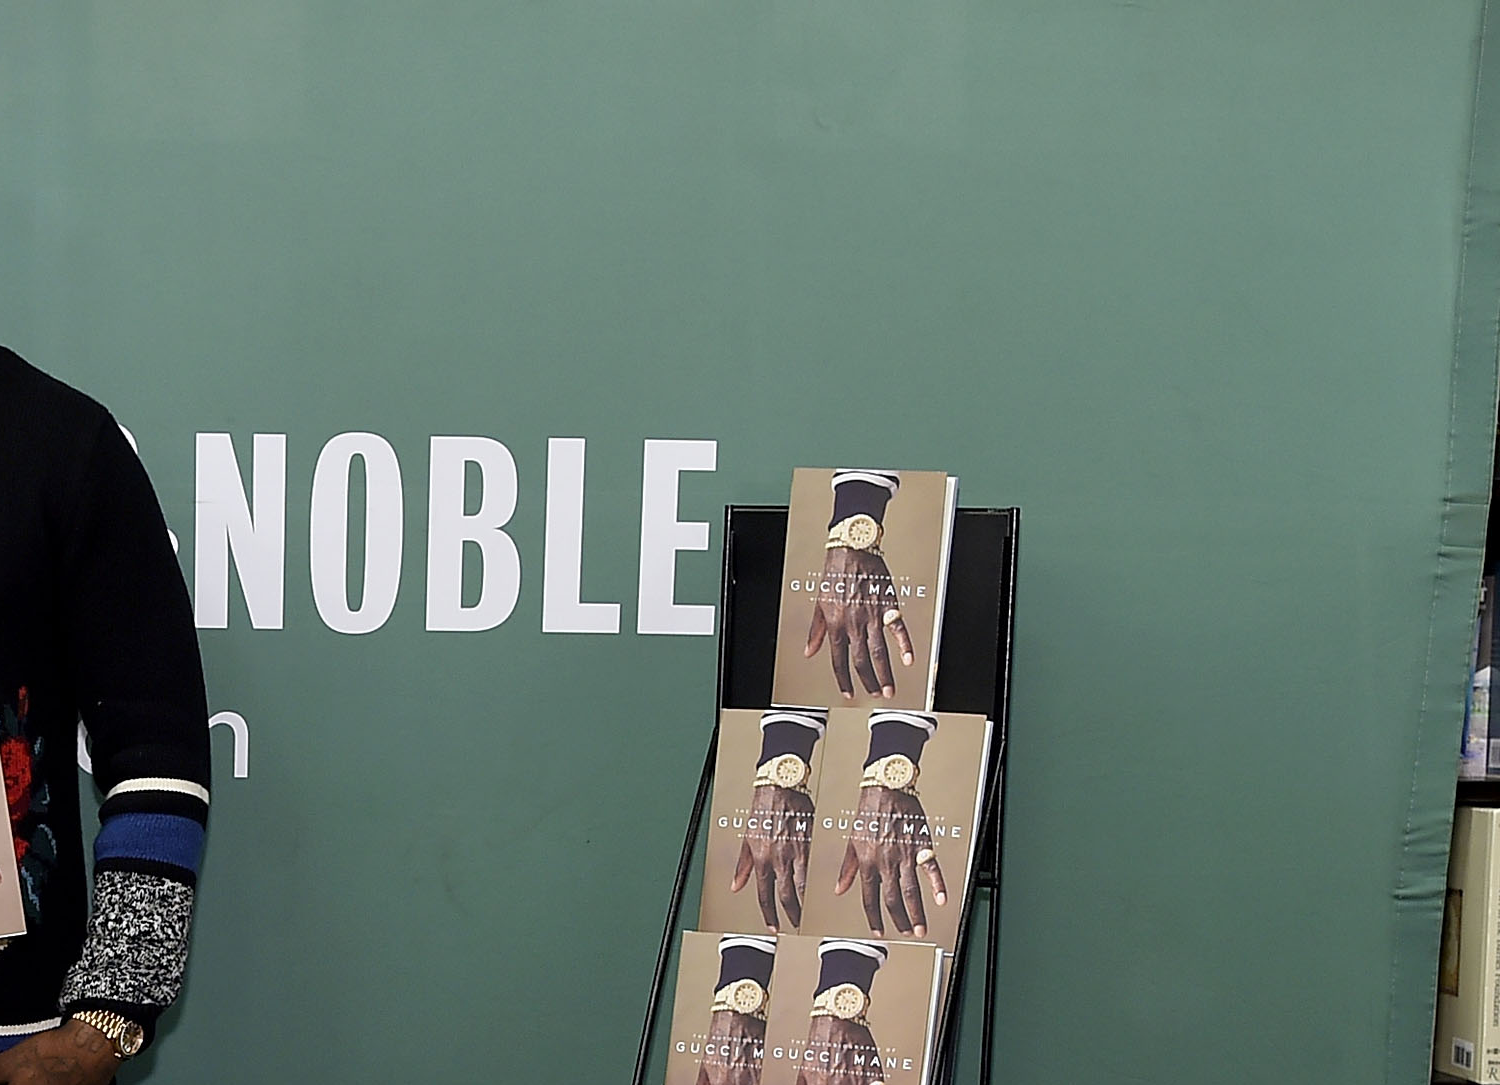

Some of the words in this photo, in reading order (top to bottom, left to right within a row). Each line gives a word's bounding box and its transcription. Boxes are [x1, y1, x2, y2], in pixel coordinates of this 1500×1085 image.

[194, 431, 717, 635] NOBLE
[790, 580, 855, 594] GUCCI
[868, 584, 926, 598] MANE
[718, 816, 783, 831] GUCCI
[822, 817, 889, 833] GUCCI
[903, 823, 961, 838] MANE
[676, 1041, 740, 1057] GUCCI
[773, 1047, 840, 1065] GUCCI
[853, 1054, 913, 1070] MANE
